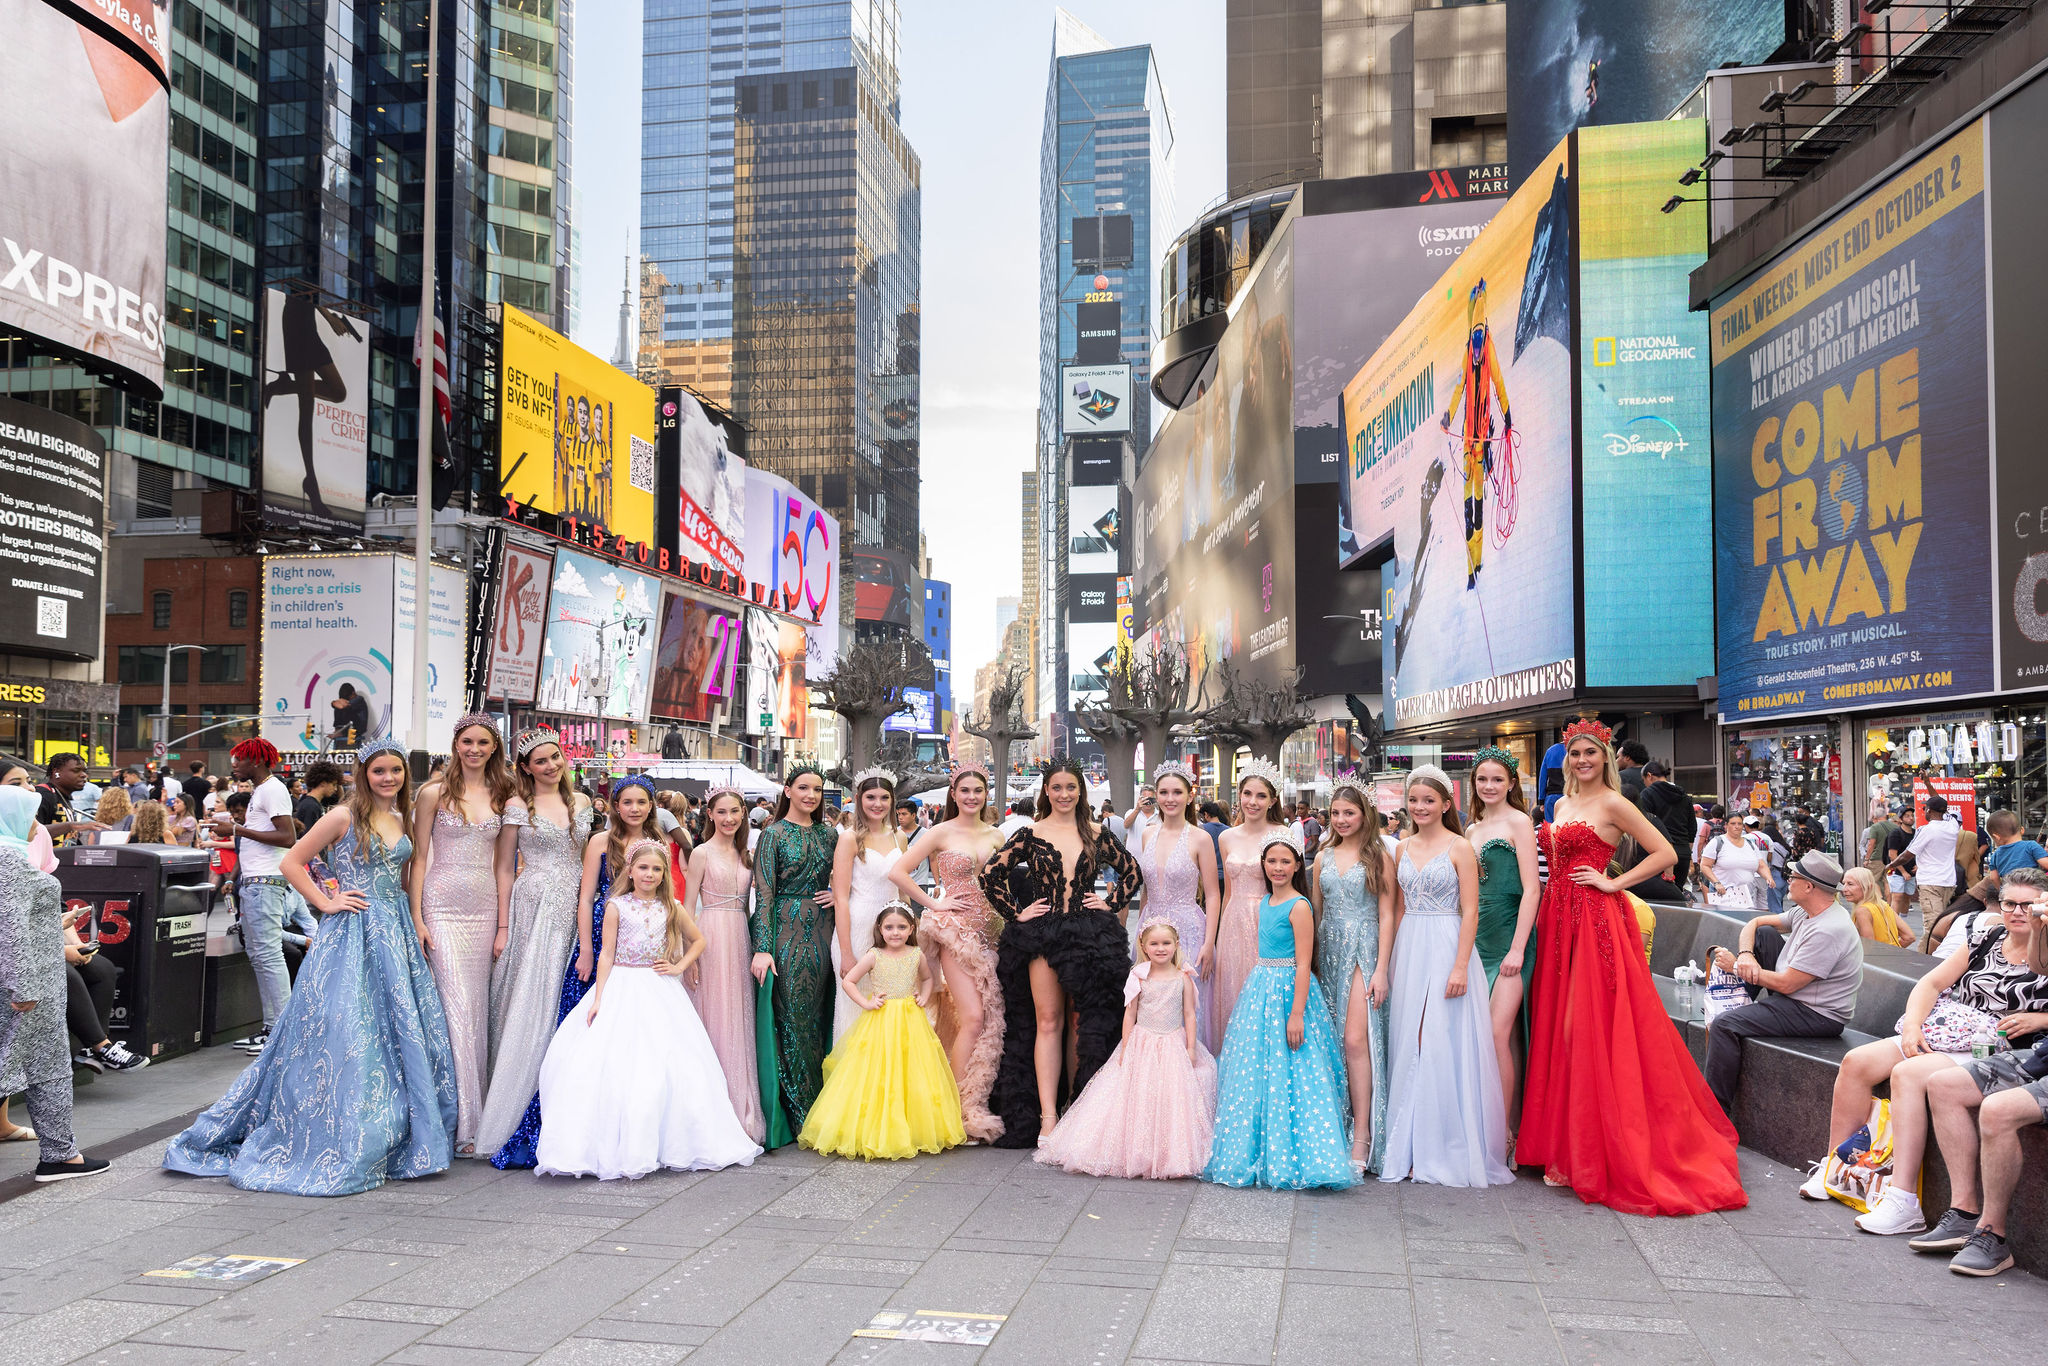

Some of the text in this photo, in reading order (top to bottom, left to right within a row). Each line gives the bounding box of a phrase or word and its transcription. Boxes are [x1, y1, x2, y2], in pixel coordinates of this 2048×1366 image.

[1721, 154, 1962, 347] FINAL WEEKS! MUST END OCTOBER 2
[1085, 292, 1113, 303] 2022
[1750, 259, 1921, 383] WINNER! BEST MUSICAL
[1080, 329, 1117, 338] SAMSUNG
[1620, 335, 1680, 350] NATIONAL
[1619, 347, 1696, 362] GEOGRAPHIC
[1751, 298, 1920, 410] ALL ACROSS NORTH AMERICA
[507, 366, 555, 404] GET YOU
[507, 386, 553, 421] BVB NFT
[1618, 396, 1658, 406] STREAM
[316, 402, 366, 429] PERFECT
[506, 412, 513, 421] AT
[534, 423, 550, 438] TIMES
[663, 419, 676, 428] LG
[1355, 417, 1378, 480] EDGE
[1382, 361, 1435, 456] UNKNOWN
[1751, 347, 1920, 489] COME
[331, 422, 366, 444] CRIME
[41, 433, 65, 453] BIG
[65, 441, 100, 469] PROJECT
[1321, 453, 1340, 462] LIST
[17, 452, 70, 476] and mentoring
[16, 465, 33, 476] and
[33, 469, 69, 486] resources
[68, 477, 77, 488] for
[15, 498, 35, 511] year,
[36, 503, 58, 516] we've
[63, 523, 80, 542] BIG
[2, 533, 34, 550] largest,
[34, 541, 54, 553] most
[30, 554, 72, 571] organization
[568, 517, 792, 613] 1540 BROADWAY
[272, 566, 335, 581] Right now,
[1752, 522, 1924, 643] AWAY
[12, 578, 43, 591] DONATE
[43, 583, 49, 592] &
[271, 583, 362, 596] there's a crisis
[1081, 590, 1106, 598] Galaxy
[271, 600, 344, 612] in children's
[270, 617, 358, 629] mental health.
[1250, 632, 1259, 652] THE
[1258, 623, 1276, 648] LEADER
[1765, 622, 1907, 661] TRUE STORY. HIT MUSICAL.
[700, 614, 742, 698] 21
[1764, 671, 1785, 685] Gerald
[1786, 665, 1825, 682] Schoenfeld
[1827, 661, 1858, 675] Theatre,
[1860, 658, 1875, 670] 236
[1878, 655, 1889, 667] W.
[1910, 650, 1923, 662] St.
[1396, 659, 1574, 720] AMERICAN EAGLE OUTFITTERS
[1823, 671, 1953, 701] COMEFROMAWAY.COM
[431, 698, 447, 708] Mind
[1738, 691, 1805, 711] ON BROADWAY
[1075, 736, 1091, 744] your
[1907, 721, 2023, 766] GRAND
[1950, 782, 1973, 790] SHOWS
[1756, 793, 1767, 801] 32
[1949, 793, 1972, 802] EVENTS
[174, 920, 192, 931] TRASH
